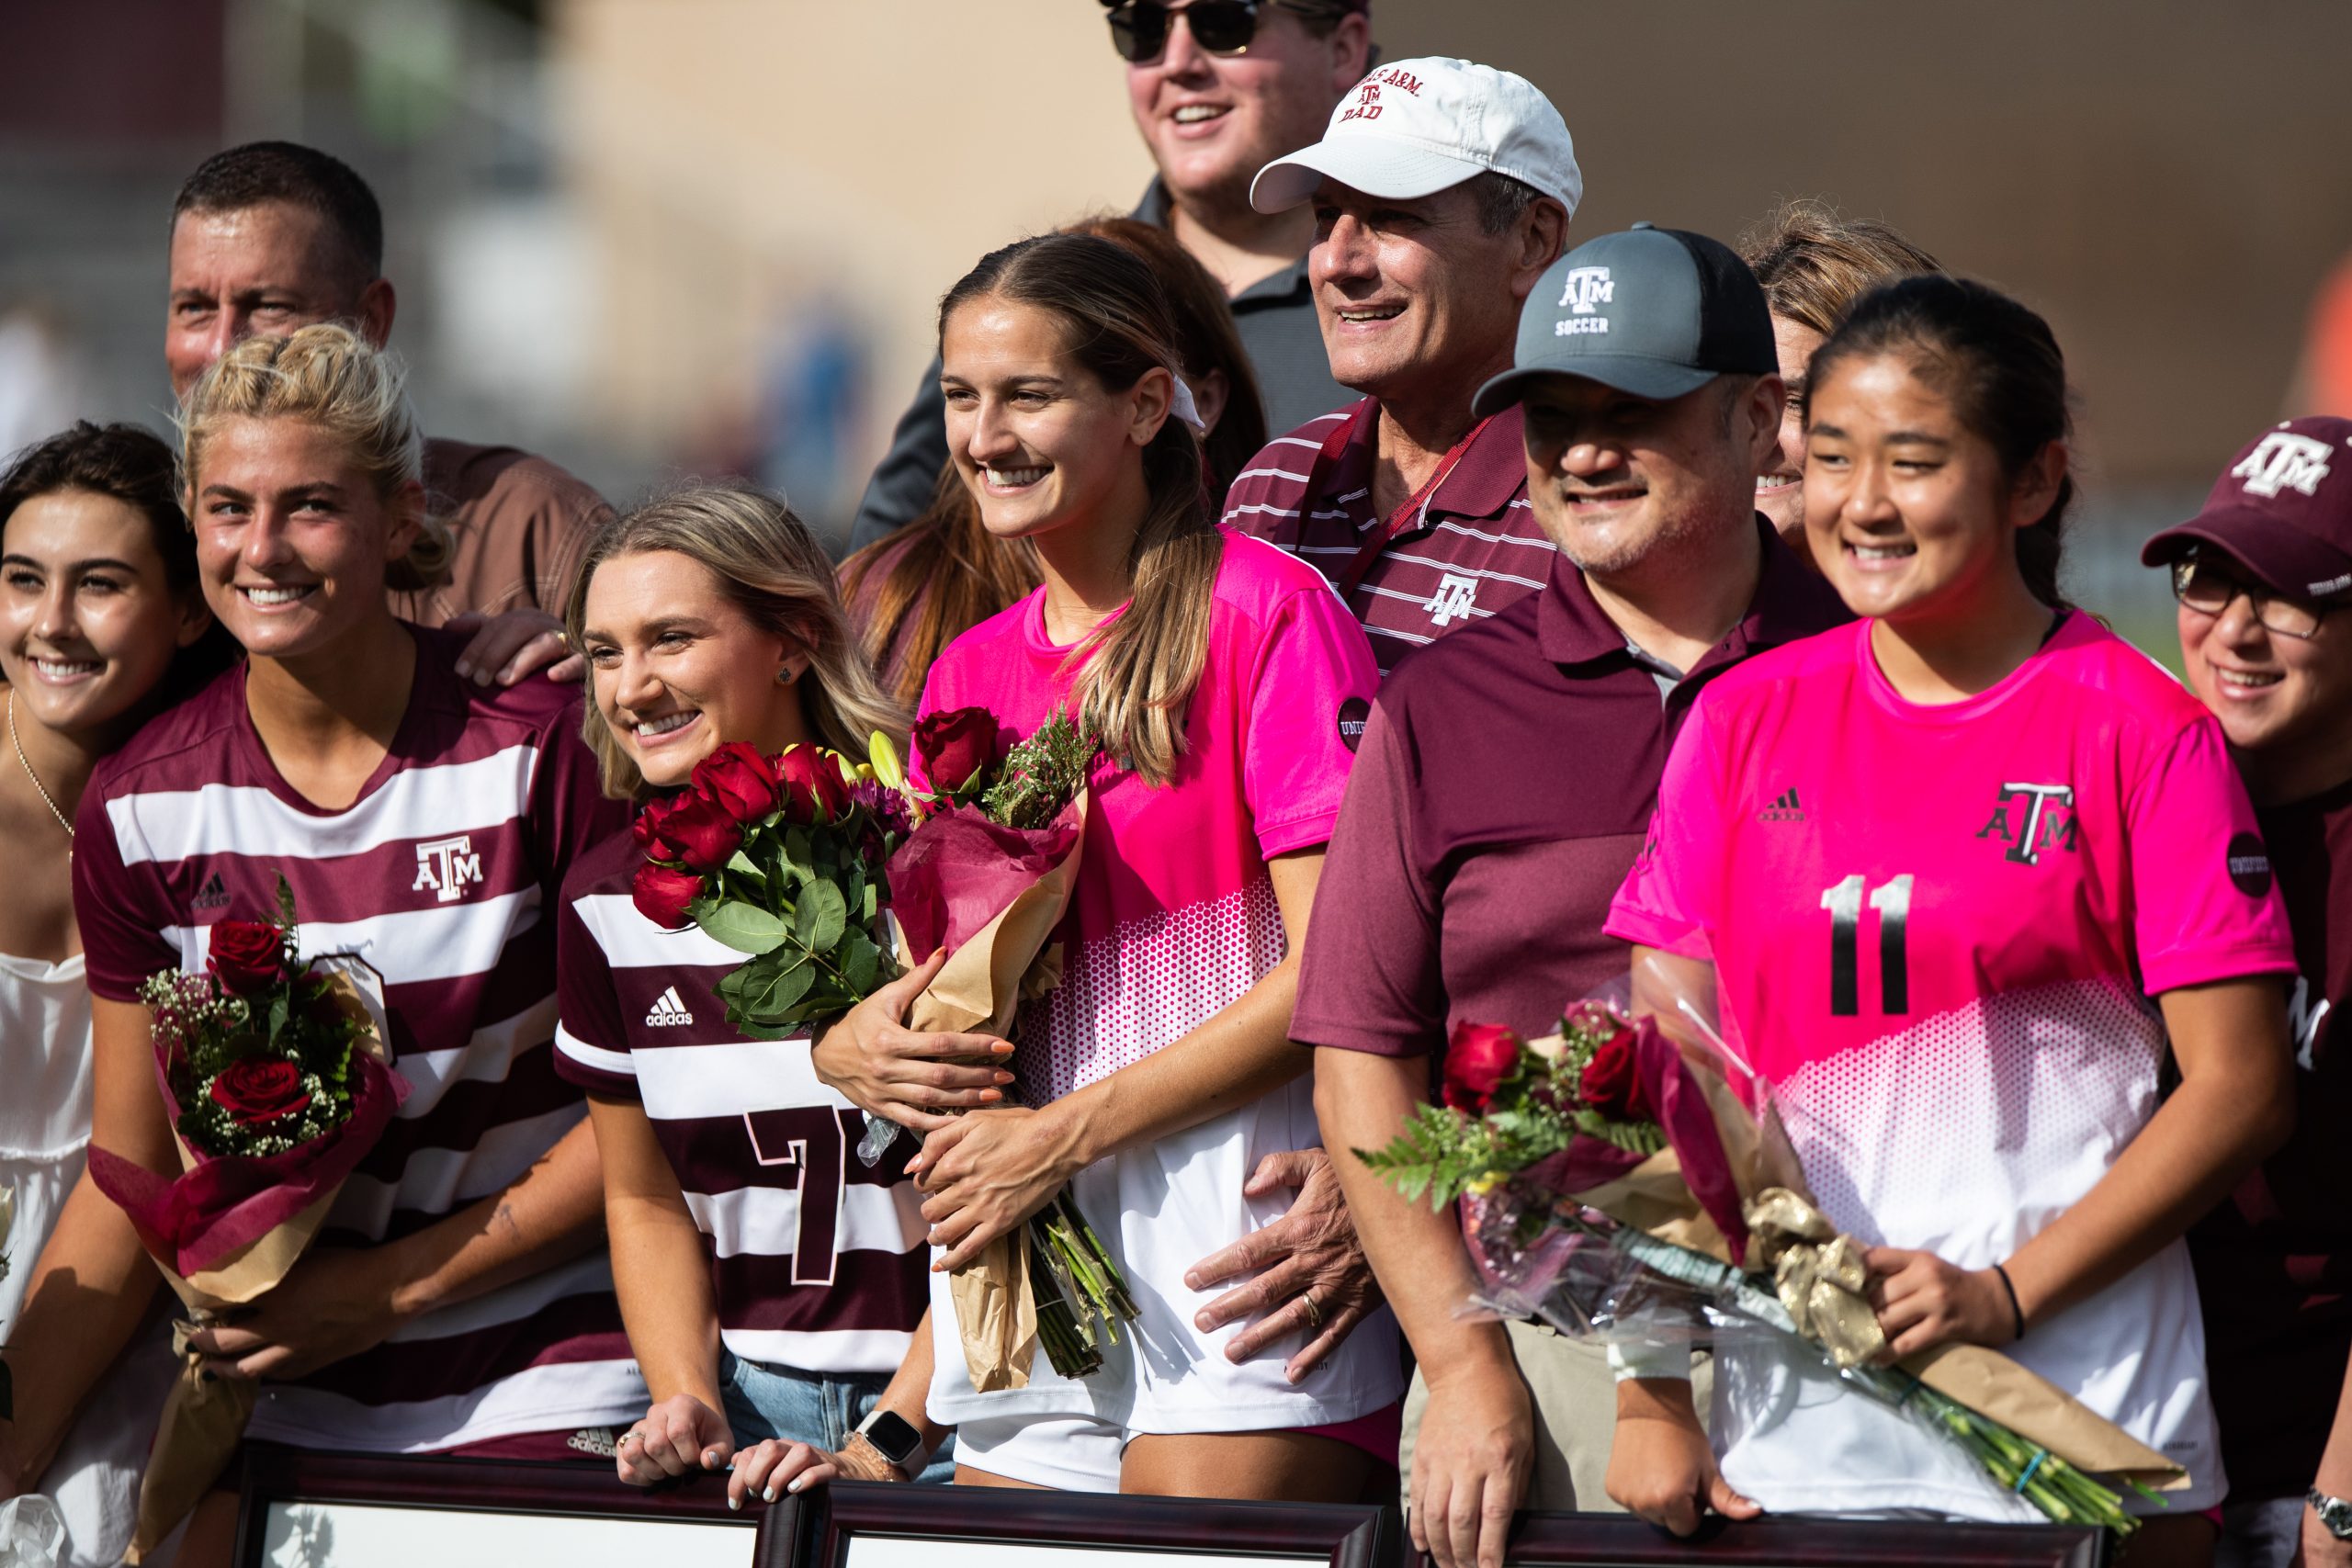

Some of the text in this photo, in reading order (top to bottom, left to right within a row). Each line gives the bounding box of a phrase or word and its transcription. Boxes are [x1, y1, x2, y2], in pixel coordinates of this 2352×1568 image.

[1383, 69, 1423, 95] A&M
[1338, 106, 1383, 123] DAD
[1555, 318, 1609, 337] SOCCER
[1820, 874, 1916, 1016] 11
[646, 1011, 694, 1028] adidas
[743, 1100, 846, 1287] 7
